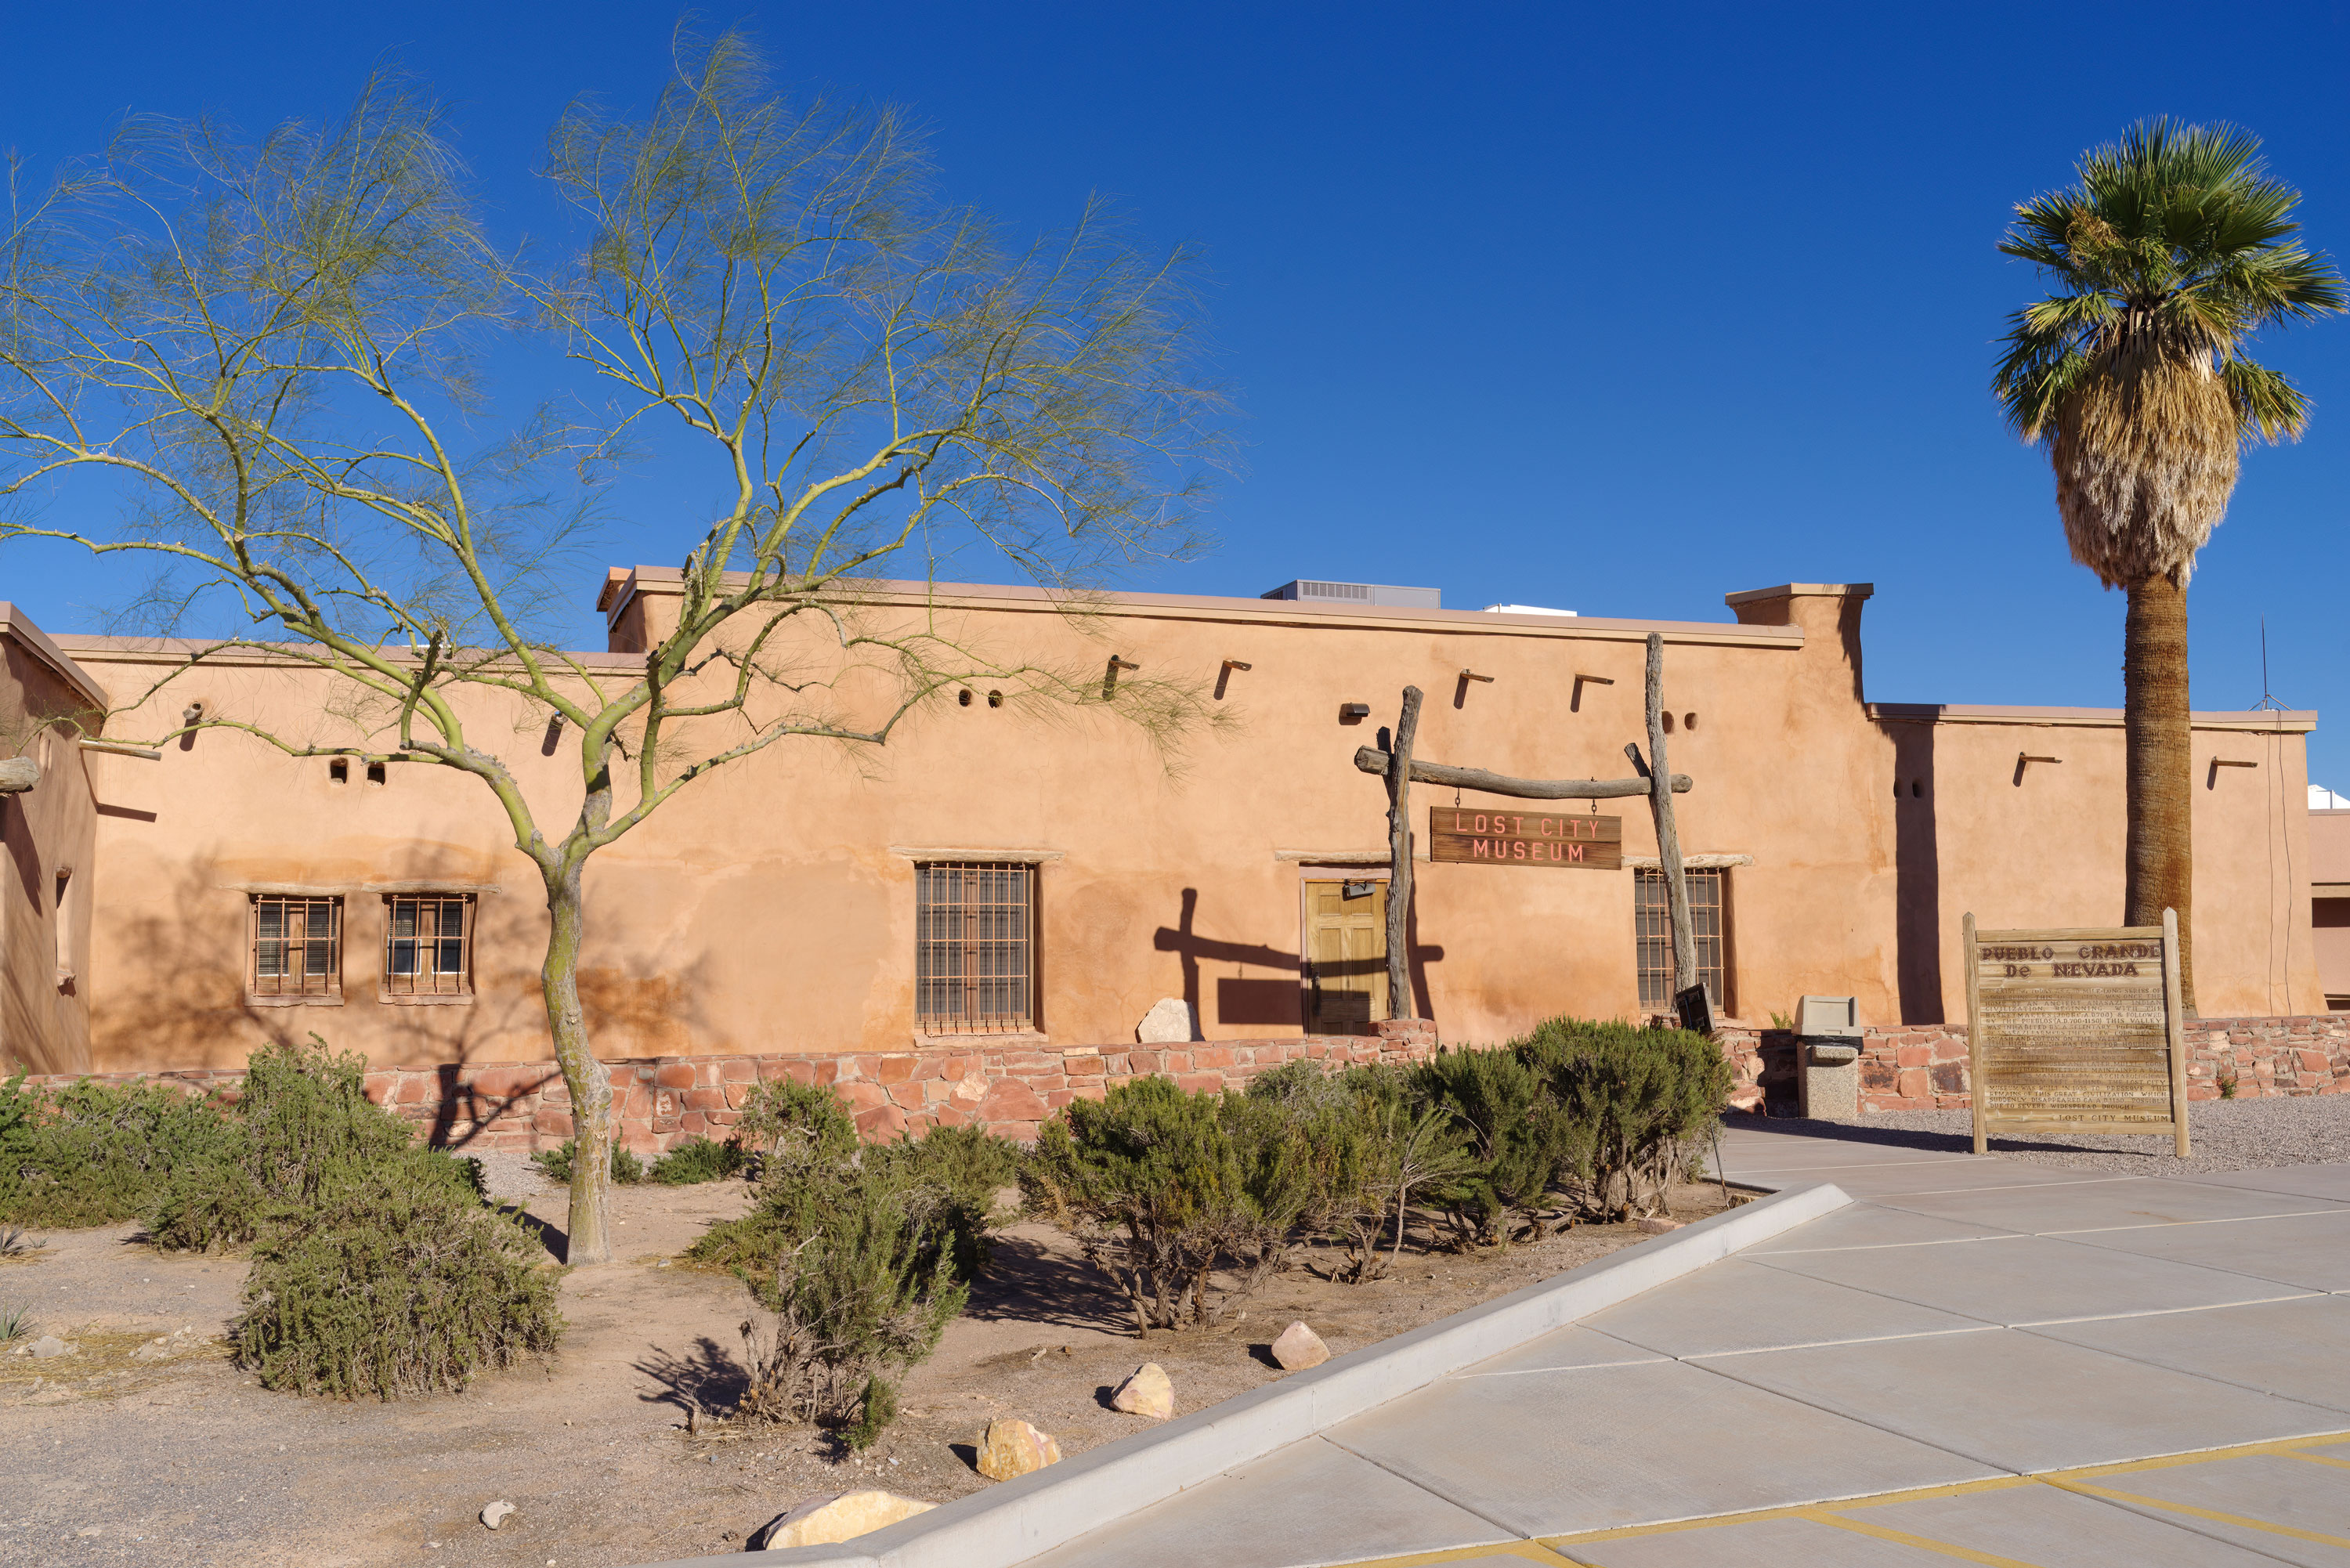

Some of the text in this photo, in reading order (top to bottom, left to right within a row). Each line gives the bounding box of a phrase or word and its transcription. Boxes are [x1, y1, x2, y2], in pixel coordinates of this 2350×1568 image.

[1455, 813, 1599, 838] LOST CITY
[1473, 839, 1583, 862] MUSEUM
[1982, 944, 2161, 961] PUEBLO GRANDE
[2005, 962, 2139, 978] De NEVADA
